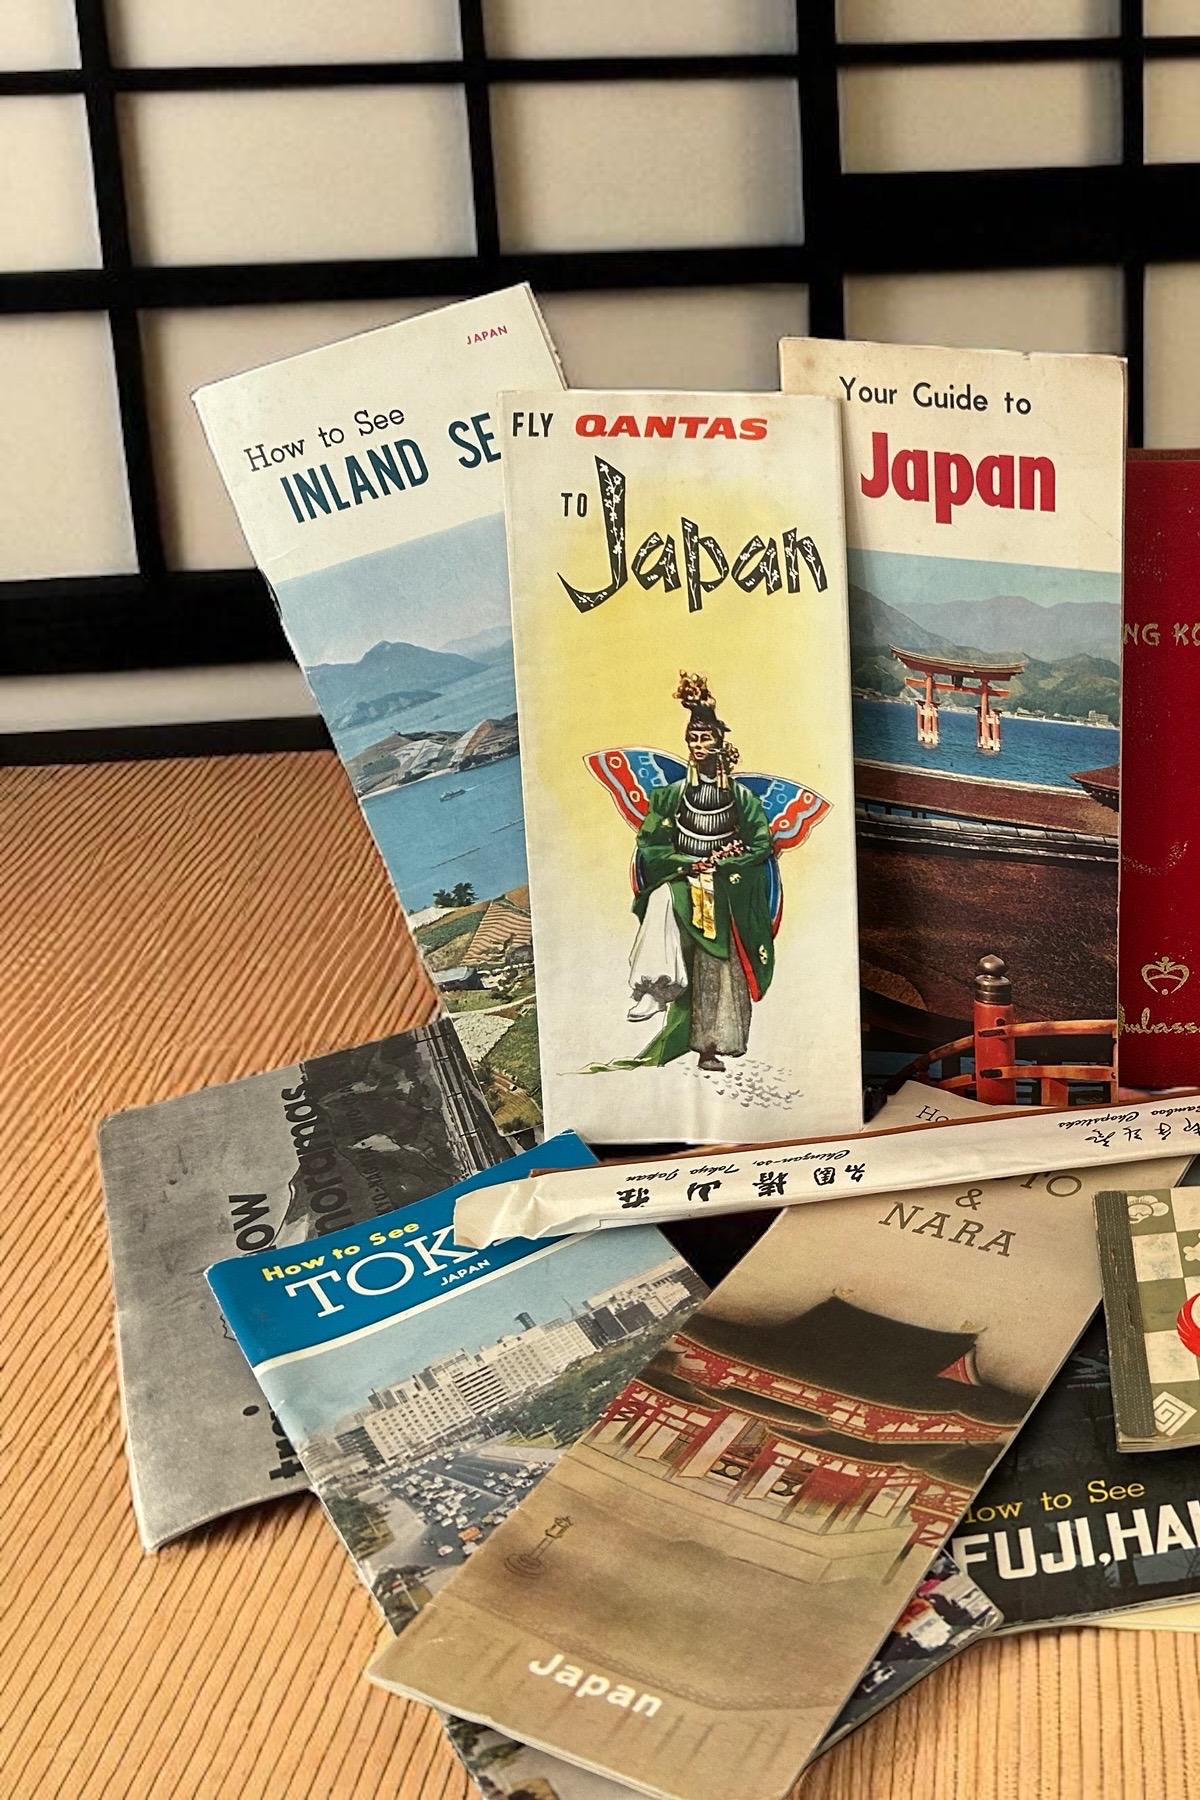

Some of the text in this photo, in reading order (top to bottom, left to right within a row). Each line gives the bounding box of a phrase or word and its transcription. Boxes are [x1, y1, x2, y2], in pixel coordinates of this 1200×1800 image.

[466, 324, 508, 345] JAPAN
[840, 376, 1032, 415] Your Guide to
[244, 409, 406, 472] How to See
[512, 412, 769, 440] FLY QANTAS
[279, 412, 502, 523] INLAND SE
[860, 431, 1056, 524] Japan
[561, 493, 588, 517] TO
[557, 455, 828, 613] Japan
[1123, 622, 1161, 647] NG
[1058, 1110, 1140, 1130] Chopsticks
[625, 1168, 680, 1182] Japan
[689, 1163, 740, 1175] Tokyo
[955, 1188, 983, 1210] &
[878, 1200, 1017, 1257] NARA
[261, 1222, 420, 1282] How to See
[284, 1224, 480, 1318] TOK
[440, 1258, 490, 1287] JAPAN
[1040, 1490, 1072, 1512] to
[1087, 1479, 1145, 1506] See
[528, 1653, 663, 1717] Japan
